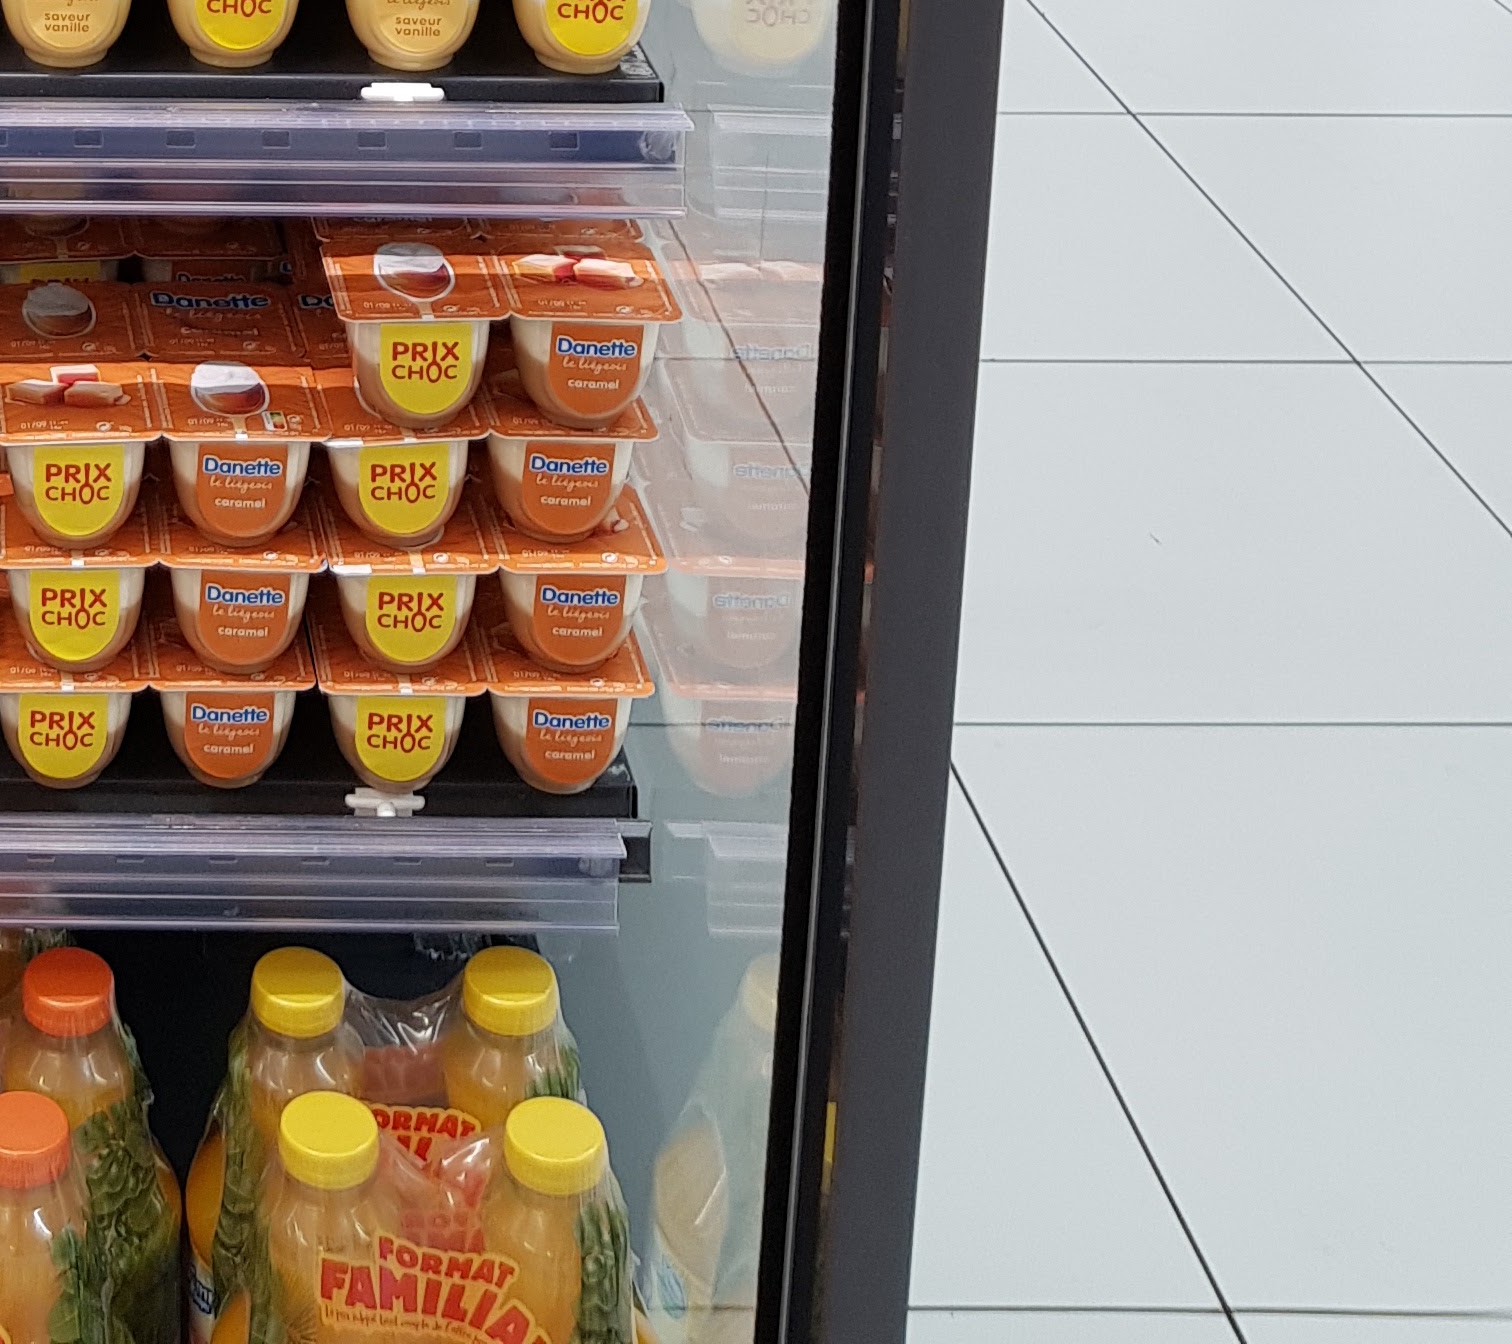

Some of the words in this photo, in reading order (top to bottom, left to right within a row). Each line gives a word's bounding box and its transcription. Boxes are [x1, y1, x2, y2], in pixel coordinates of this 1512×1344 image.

[151, 291, 270, 310] Danette
[557, 337, 637, 357] Danette
[568, 378, 620, 390] caramel
[379, 1235, 515, 1289] FORMAT
[321, 1258, 546, 1344] FAMILIA
